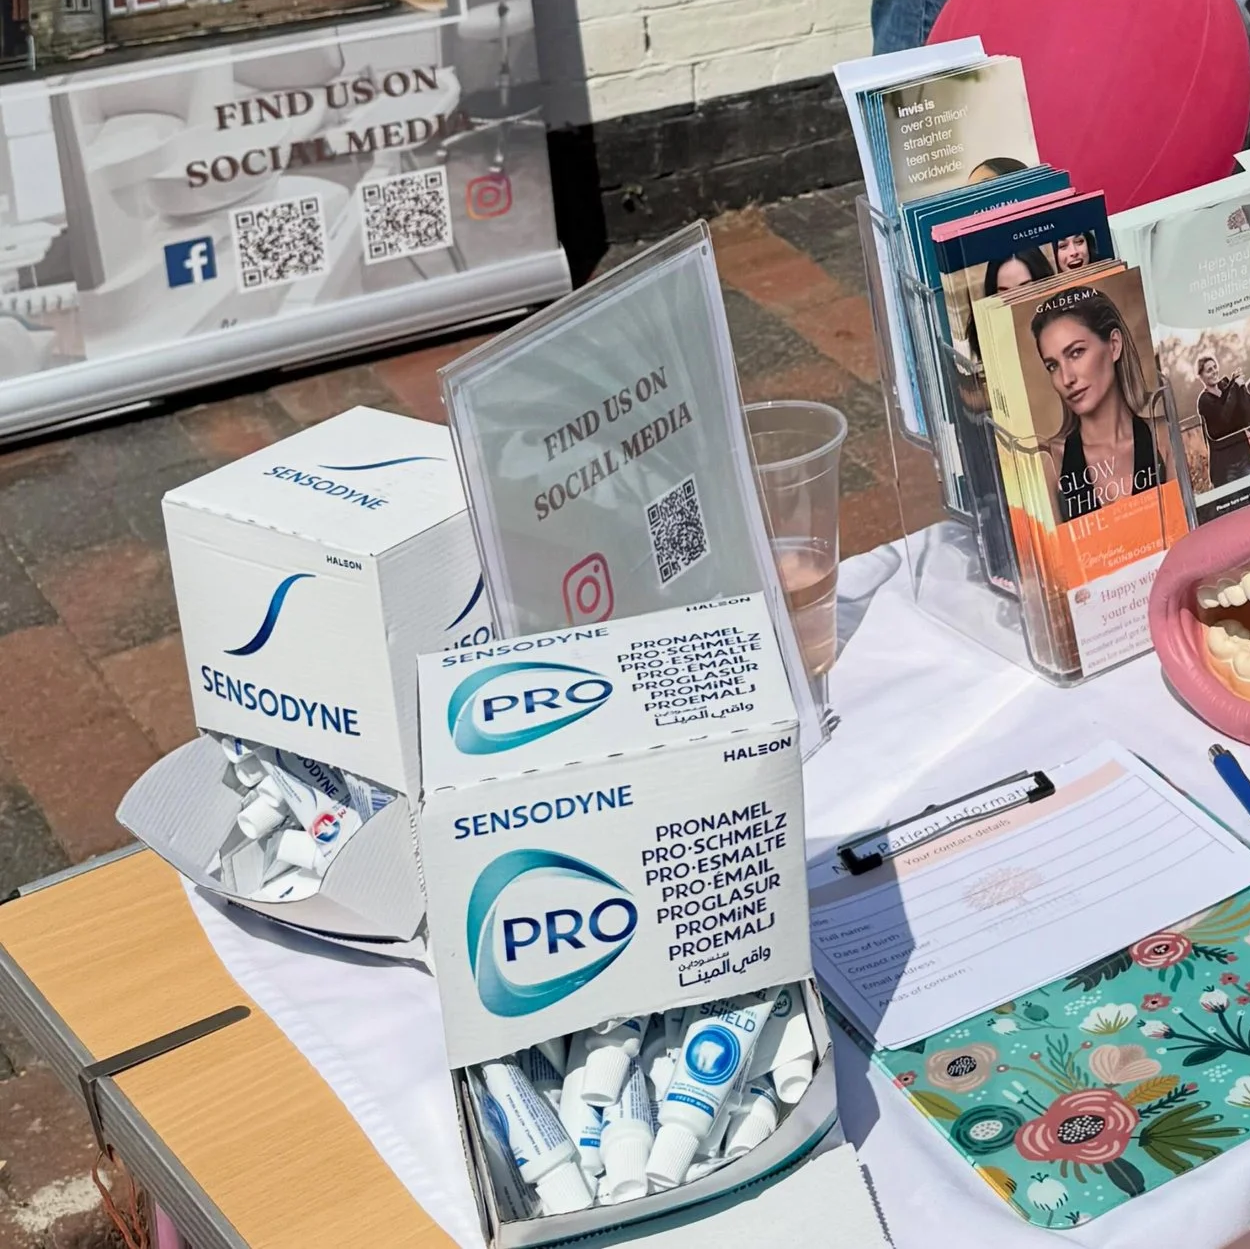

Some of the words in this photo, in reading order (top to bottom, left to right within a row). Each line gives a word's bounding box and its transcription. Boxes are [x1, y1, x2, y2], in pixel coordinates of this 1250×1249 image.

[214, 90, 314, 132] FIND
[325, 79, 374, 111] US
[383, 65, 440, 97] ON
[898, 102, 924, 118] invis
[924, 99, 935, 111] is
[901, 120, 924, 134] over
[925, 116, 933, 128] 3
[903, 129, 953, 151] straighter
[185, 135, 338, 190] SOCIAL
[346, 110, 476, 157] MEDIA
[906, 153, 930, 167] teen
[931, 143, 964, 160] smiles
[1012, 223, 1055, 240] GALDERMA
[1035, 287, 1099, 315] GALDERMA
[543, 408, 601, 463] FIND
[604, 387, 633, 425] US
[635, 366, 669, 404] ON
[534, 456, 619, 521] SOCIAL
[620, 401, 694, 466] MEDIA
[1058, 455, 1117, 495] GLOW
[263, 466, 389, 511] SENSODYNE
[1065, 462, 1161, 519] THROUGH
[1068, 514, 1109, 543] LIFE
[326, 554, 363, 571] HALEON
[686, 596, 751, 612] HALEON
[1100, 580, 1137, 603] Happy
[1101, 605, 1128, 626] your
[442, 626, 609, 668] SENSODYNE
[631, 626, 744, 650] PRONAMEL
[632, 663, 758, 692] PROGLASUR
[201, 665, 361, 737] SENSODYNE
[484, 679, 613, 722] PRO
[644, 683, 757, 712] PROEMALJ
[723, 736, 792, 763] HALEON
[454, 784, 633, 840] SENSODYNE
[655, 800, 773, 843] PRONAMEL
[877, 821, 941, 855] Patient
[904, 853, 930, 867] Your
[933, 834, 973, 855] contact
[975, 819, 1011, 838] details
[656, 873, 781, 925] PROGLASUR
[503, 897, 638, 963] PRO
[668, 912, 775, 962] PROEMALJ
[819, 930, 839, 942] Full
[732, 944, 771, 974] واقي
[833, 946, 859, 960] Date
[861, 942, 873, 952] of
[874, 933, 900, 947] birth
[848, 956, 888, 975] Contact
[862, 975, 892, 991] Email
[894, 959, 936, 979] address
[878, 991, 908, 1009] Areas
[910, 986, 922, 997] of
[924, 968, 966, 990] concern
[700, 1003, 756, 1033] SHIELD
